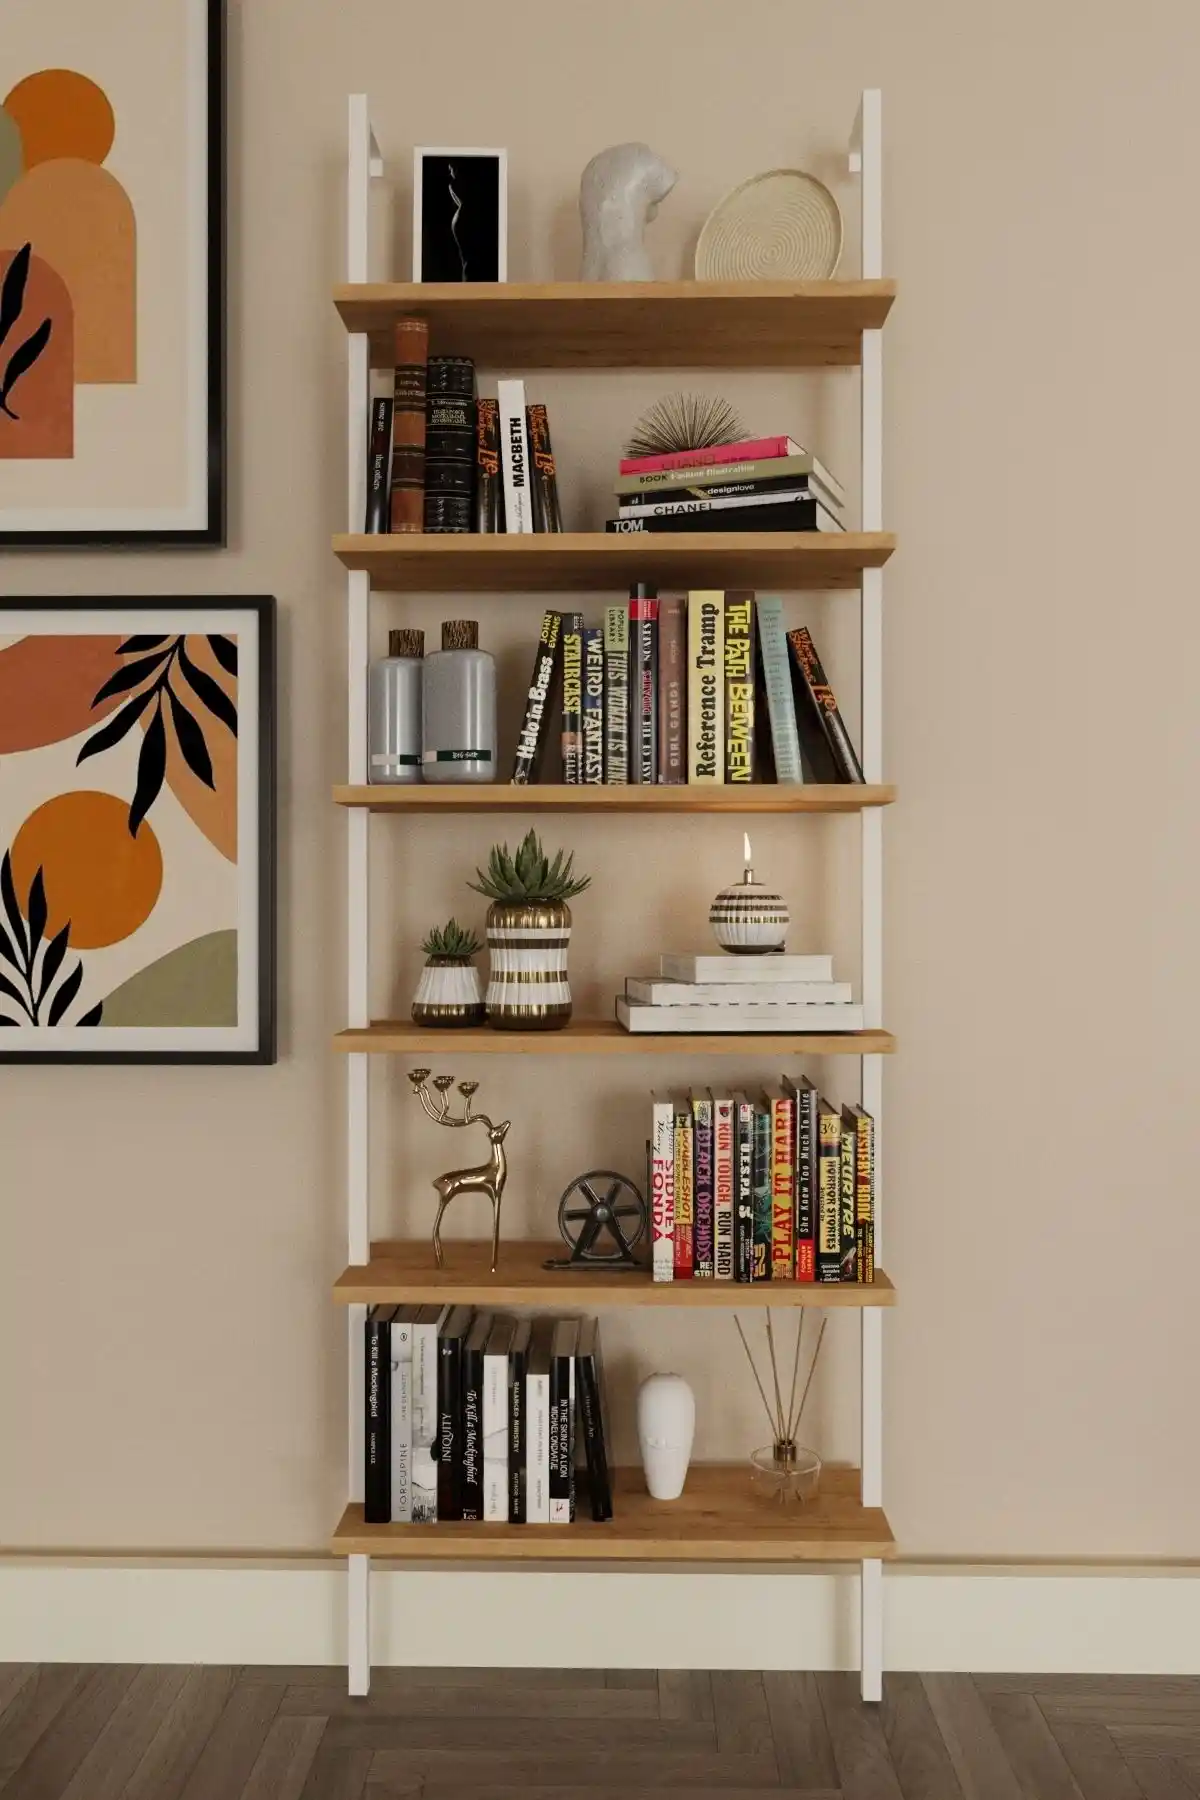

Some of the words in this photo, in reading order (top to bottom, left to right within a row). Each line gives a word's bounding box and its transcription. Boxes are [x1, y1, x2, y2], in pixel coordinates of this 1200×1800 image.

[378, 401, 387, 420] some
[375, 454, 384, 468] than
[510, 417, 525, 488] MACBETH
[639, 474, 669, 484] BOOK
[613, 519, 644, 533] TOM
[540, 614, 552, 644] JOHN
[548, 615, 561, 649] EVANS
[608, 609, 616, 643] LIBRARY
[696, 602, 720, 669] Tramp
[725, 600, 751, 638] THE
[563, 633, 582, 715] STAIRCASE
[586, 638, 603, 697] WEIRD
[607, 651, 628, 681] THIS
[724, 638, 751, 678] PATH
[528, 655, 554, 702] Brass
[526, 703, 544, 719] in
[607, 685, 628, 733] WOMAN
[669, 681, 681, 729] GANGS
[516, 721, 541, 760] Halo
[696, 674, 716, 778] Reference
[727, 683, 754, 781] BETWEEN
[565, 743, 576, 785] REILLY
[584, 708, 603, 785] FANTASY
[607, 740, 627, 753] IS
[669, 734, 680, 767] GIRL
[801, 1093, 809, 1114] Live
[717, 1122, 731, 1151] RUN
[775, 1100, 794, 1164] HARD
[801, 1120, 809, 1131] To
[696, 1129, 712, 1186] BLACK
[801, 1134, 809, 1160] Much
[857, 1117, 871, 1182] MYSTERY
[681, 1129, 691, 1223] DOUBLESHOT
[716, 1158, 731, 1207] TOUGH,
[773, 1173, 794, 1196] IT
[801, 1166, 809, 1182] Too
[826, 1160, 837, 1205] HORROR
[841, 1133, 855, 1239] MEURTRE
[652, 1159, 665, 1243] FONDA
[664, 1159, 674, 1241] SIDNEY
[801, 1187, 809, 1211] Knew
[857, 1183, 872, 1223] BOOK
[696, 1190, 712, 1262] ORCHIDS
[717, 1211, 732, 1238] RUN
[772, 1207, 793, 1262] PLAY
[801, 1215, 809, 1233] She
[826, 1206, 837, 1251] STORIES
[717, 1242, 731, 1275] HARD
[370, 1346, 378, 1359] Kill
[371, 1335, 378, 1345] To
[369, 1367, 378, 1417] Mockingbird
[466, 1390, 477, 1402] To
[560, 1398, 568, 1407] IN
[466, 1403, 478, 1421] Kill
[550, 1406, 558, 1435] MICHAEL
[560, 1408, 568, 1423] THE
[441, 1412, 453, 1462] INIQUITY
[560, 1424, 568, 1442] SKIN
[560, 1442, 568, 1453] OF
[462, 1429, 477, 1485] Mockingbird
[550, 1435, 558, 1470] ONDAATJE
[560, 1460, 568, 1478] LION
[399, 1443, 407, 1512] PORCUPINE
